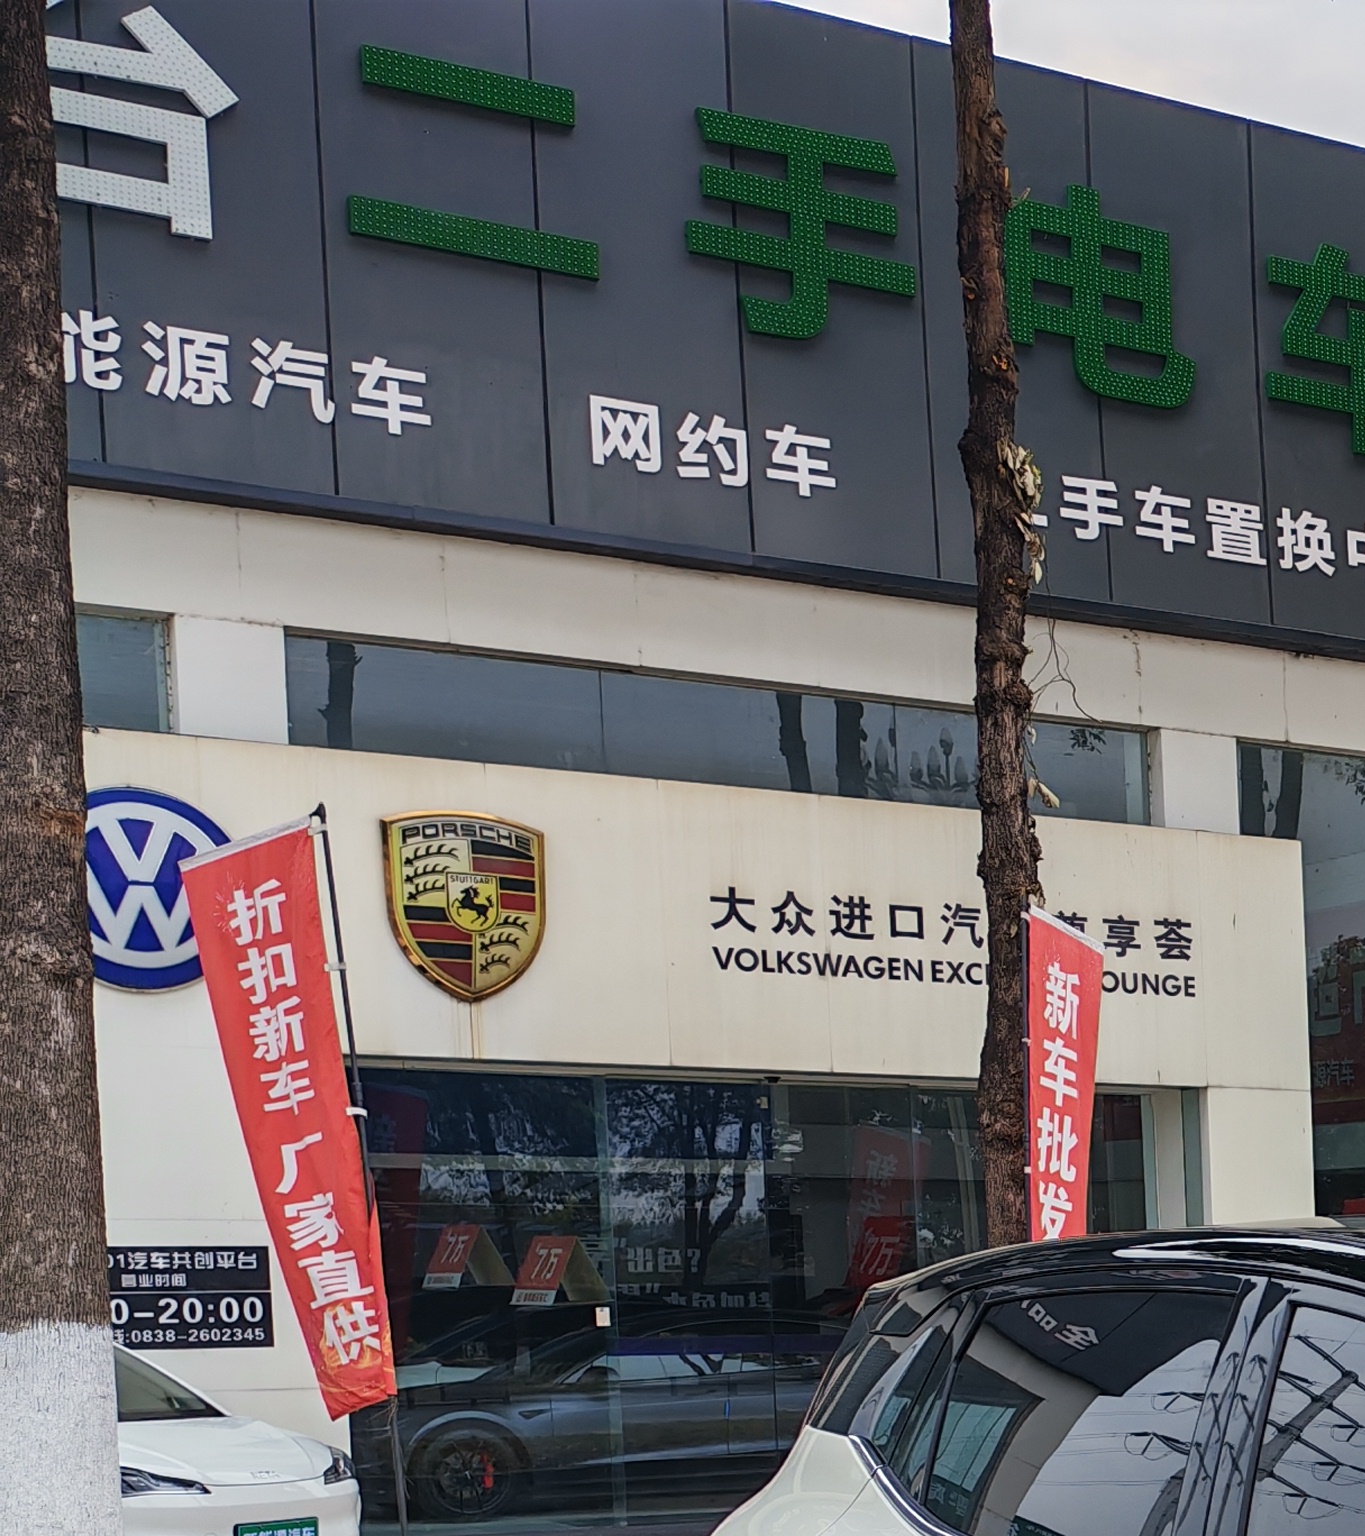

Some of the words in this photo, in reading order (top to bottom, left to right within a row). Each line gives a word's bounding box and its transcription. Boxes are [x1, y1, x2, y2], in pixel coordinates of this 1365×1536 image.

[62, 310, 432, 436] 能源汽车
[588, 394, 838, 498] 网约车
[401, 822, 533, 853] PORSCHE
[711, 946, 923, 984] VOLKSWAGEN
[228, 877, 317, 1116] 折扣新车
[274, 1131, 382, 1365] 厂家直供
[1035, 961, 1082, 1240] 新车批发
